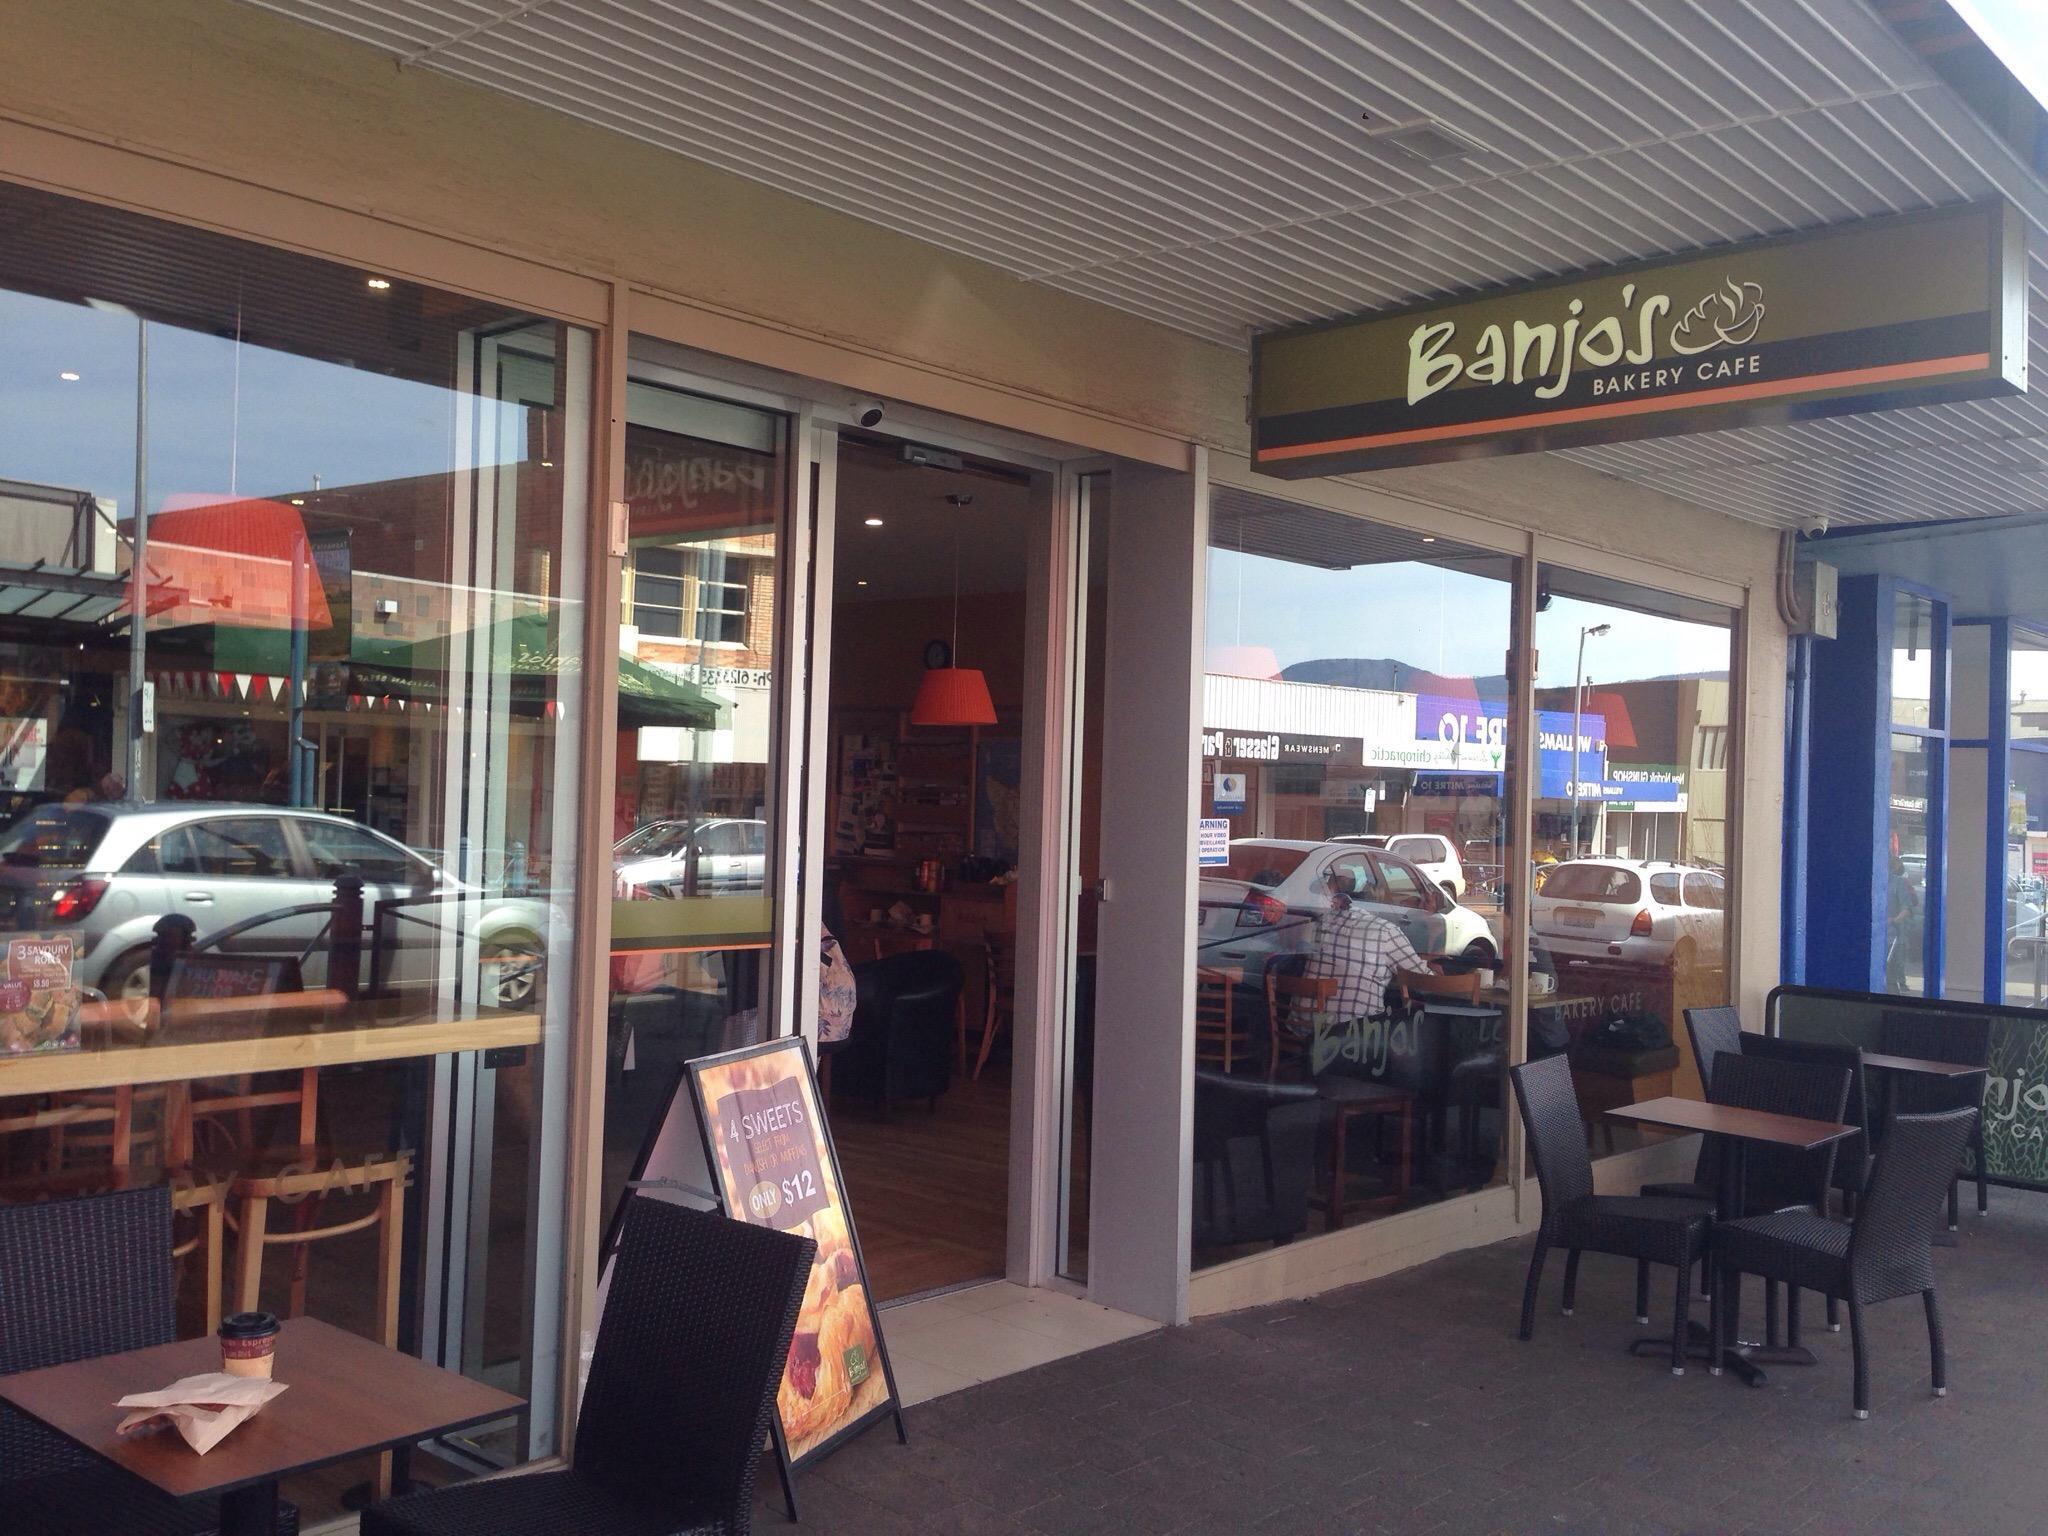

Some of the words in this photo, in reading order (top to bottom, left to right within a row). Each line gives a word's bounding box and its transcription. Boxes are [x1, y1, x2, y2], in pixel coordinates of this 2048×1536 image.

[1407, 283, 1670, 406] Banjo's
[1593, 366, 1684, 396] BAKERY
[1697, 355, 1760, 380] CAFE
[1200, 820, 1228, 829] ARNING
[27, 944, 70, 956] SAVOURY
[1554, 999, 1603, 1021] BAKERY
[1611, 991, 1643, 1012] CAFE
[1312, 999, 1425, 1077] Banjo's
[729, 1119, 740, 1142] 4
[741, 1099, 804, 1140] SWEETS
[752, 1187, 777, 1212] ONLY
[782, 1169, 817, 1208] $12
